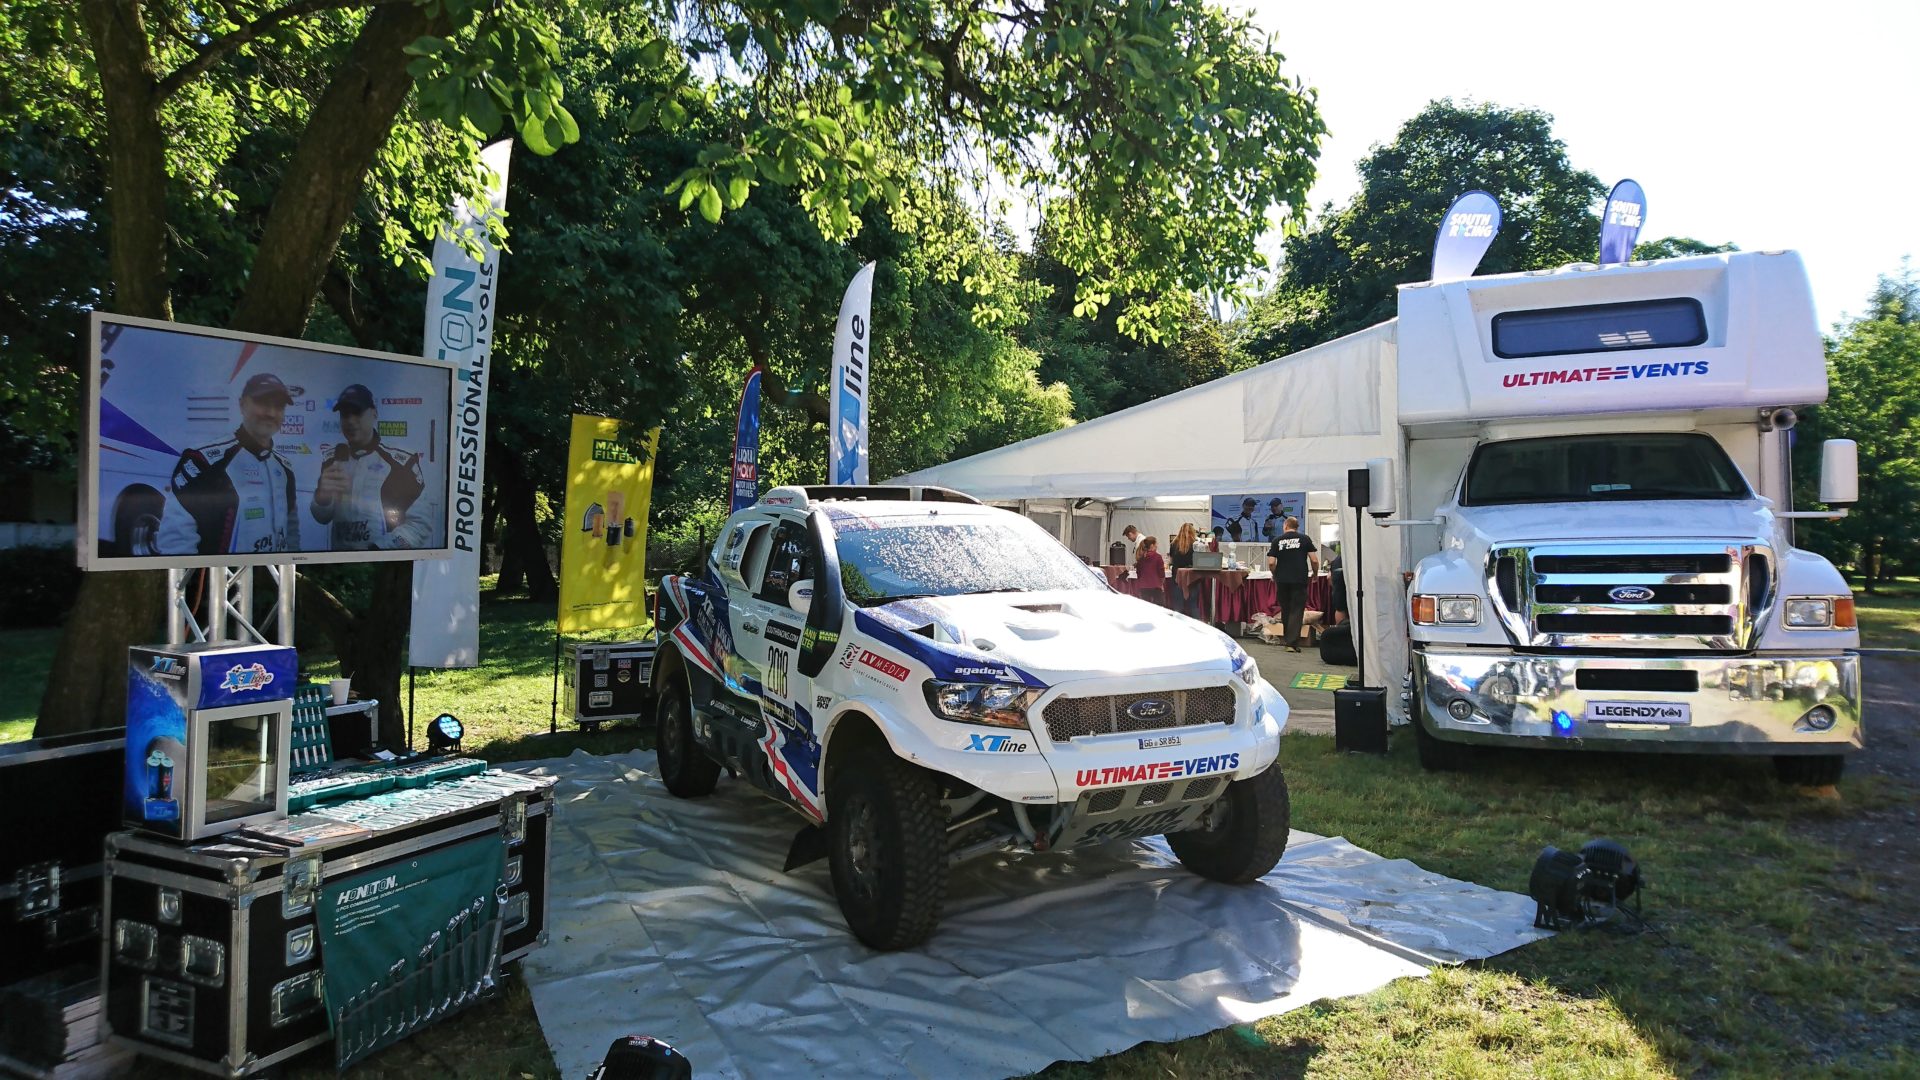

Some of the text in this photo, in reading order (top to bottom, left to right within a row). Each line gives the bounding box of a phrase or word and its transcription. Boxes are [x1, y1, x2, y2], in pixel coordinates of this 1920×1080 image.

[1611, 200, 1640, 215] SOUTH
[1451, 213, 1491, 225] SOUTH
[454, 355, 484, 552] PROFESSIONAL
[736, 463, 754, 479] MOLY
[1279, 538, 1300, 546] SOUTH
[1618, 588, 1644, 599] Ford
[803, 628, 817, 640] ANN
[801, 639, 815, 650] LTER
[767, 645, 788, 699] 2018
[861, 652, 906, 680] AVMEDIA
[954, 666, 1004, 676] agados
[1139, 701, 1166, 716] Ford
[1595, 705, 1661, 718] LEGENDY
[962, 733, 1027, 753] XTline
[1143, 739, 1153, 748] GG
[336, 874, 397, 906] HONITON
